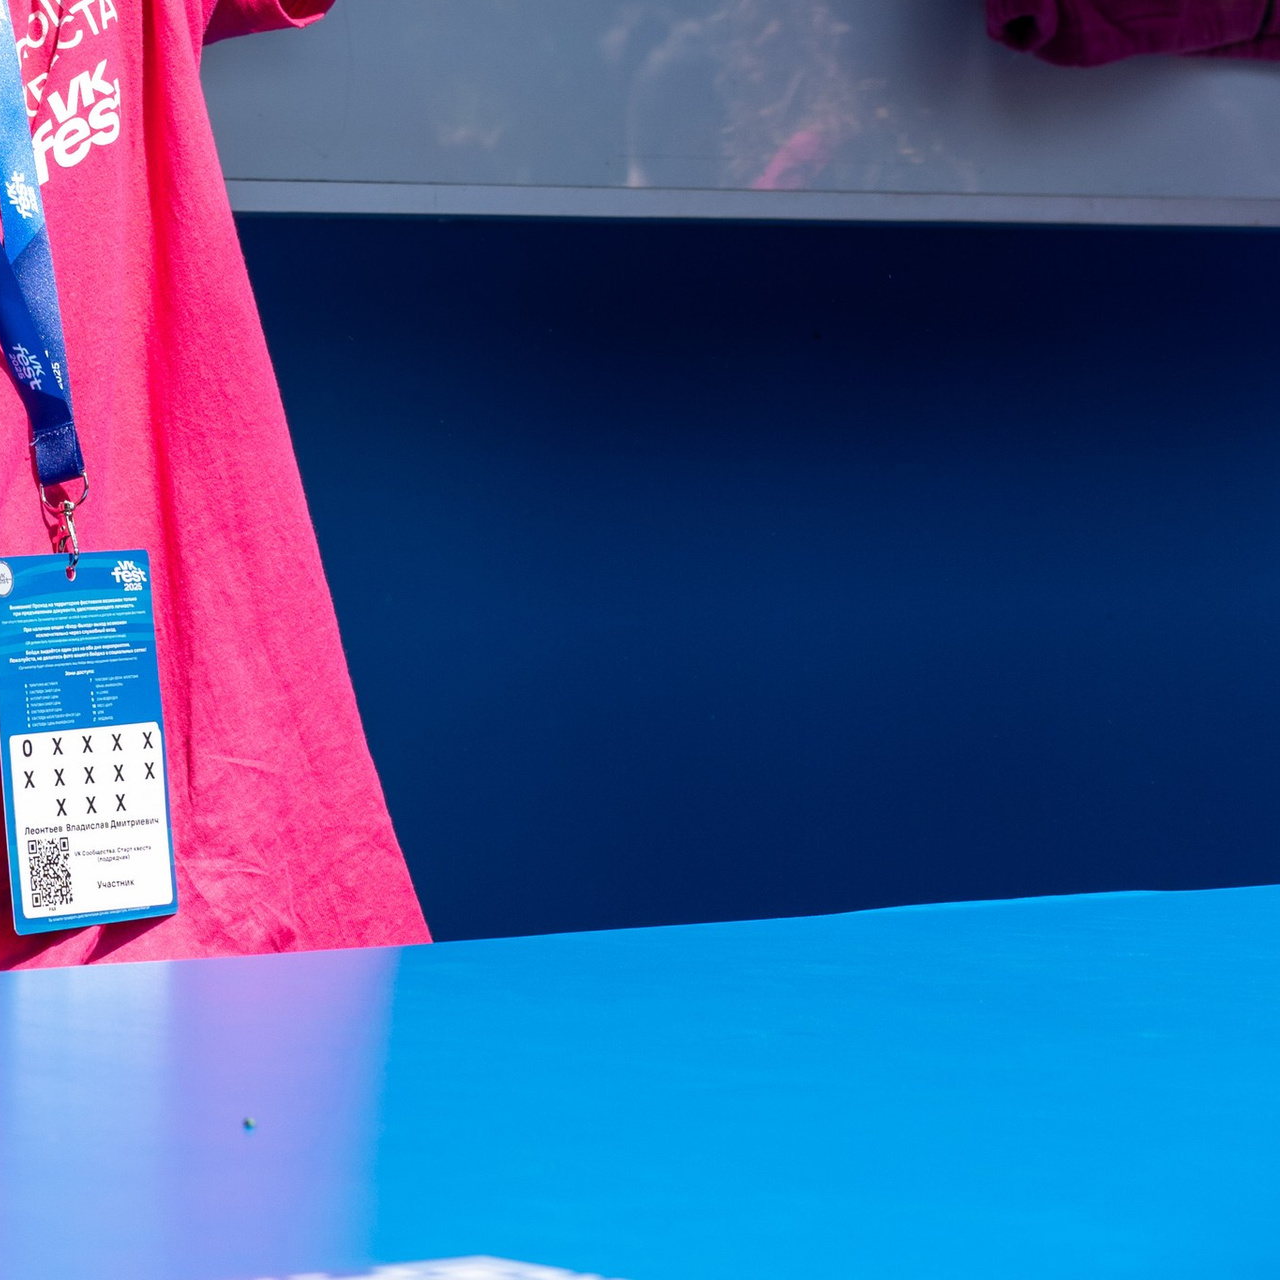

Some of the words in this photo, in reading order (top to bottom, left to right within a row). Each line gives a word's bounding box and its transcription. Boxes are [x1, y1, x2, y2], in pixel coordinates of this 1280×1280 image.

[47, 58, 115, 124] VK
[31, 78, 121, 187] fes
[11, 170, 33, 219] fest
[12, 343, 42, 391] fest
[28, 355, 46, 377] VK
[111, 564, 147, 583] fest
[117, 561, 137, 570] VK
[123, 583, 143, 591] 2025
[24, 826, 62, 836] Леонтьев
[66, 822, 110, 832] Владислав
[110, 818, 159, 829] Дмитриевич
[97, 880, 134, 888] Участник
